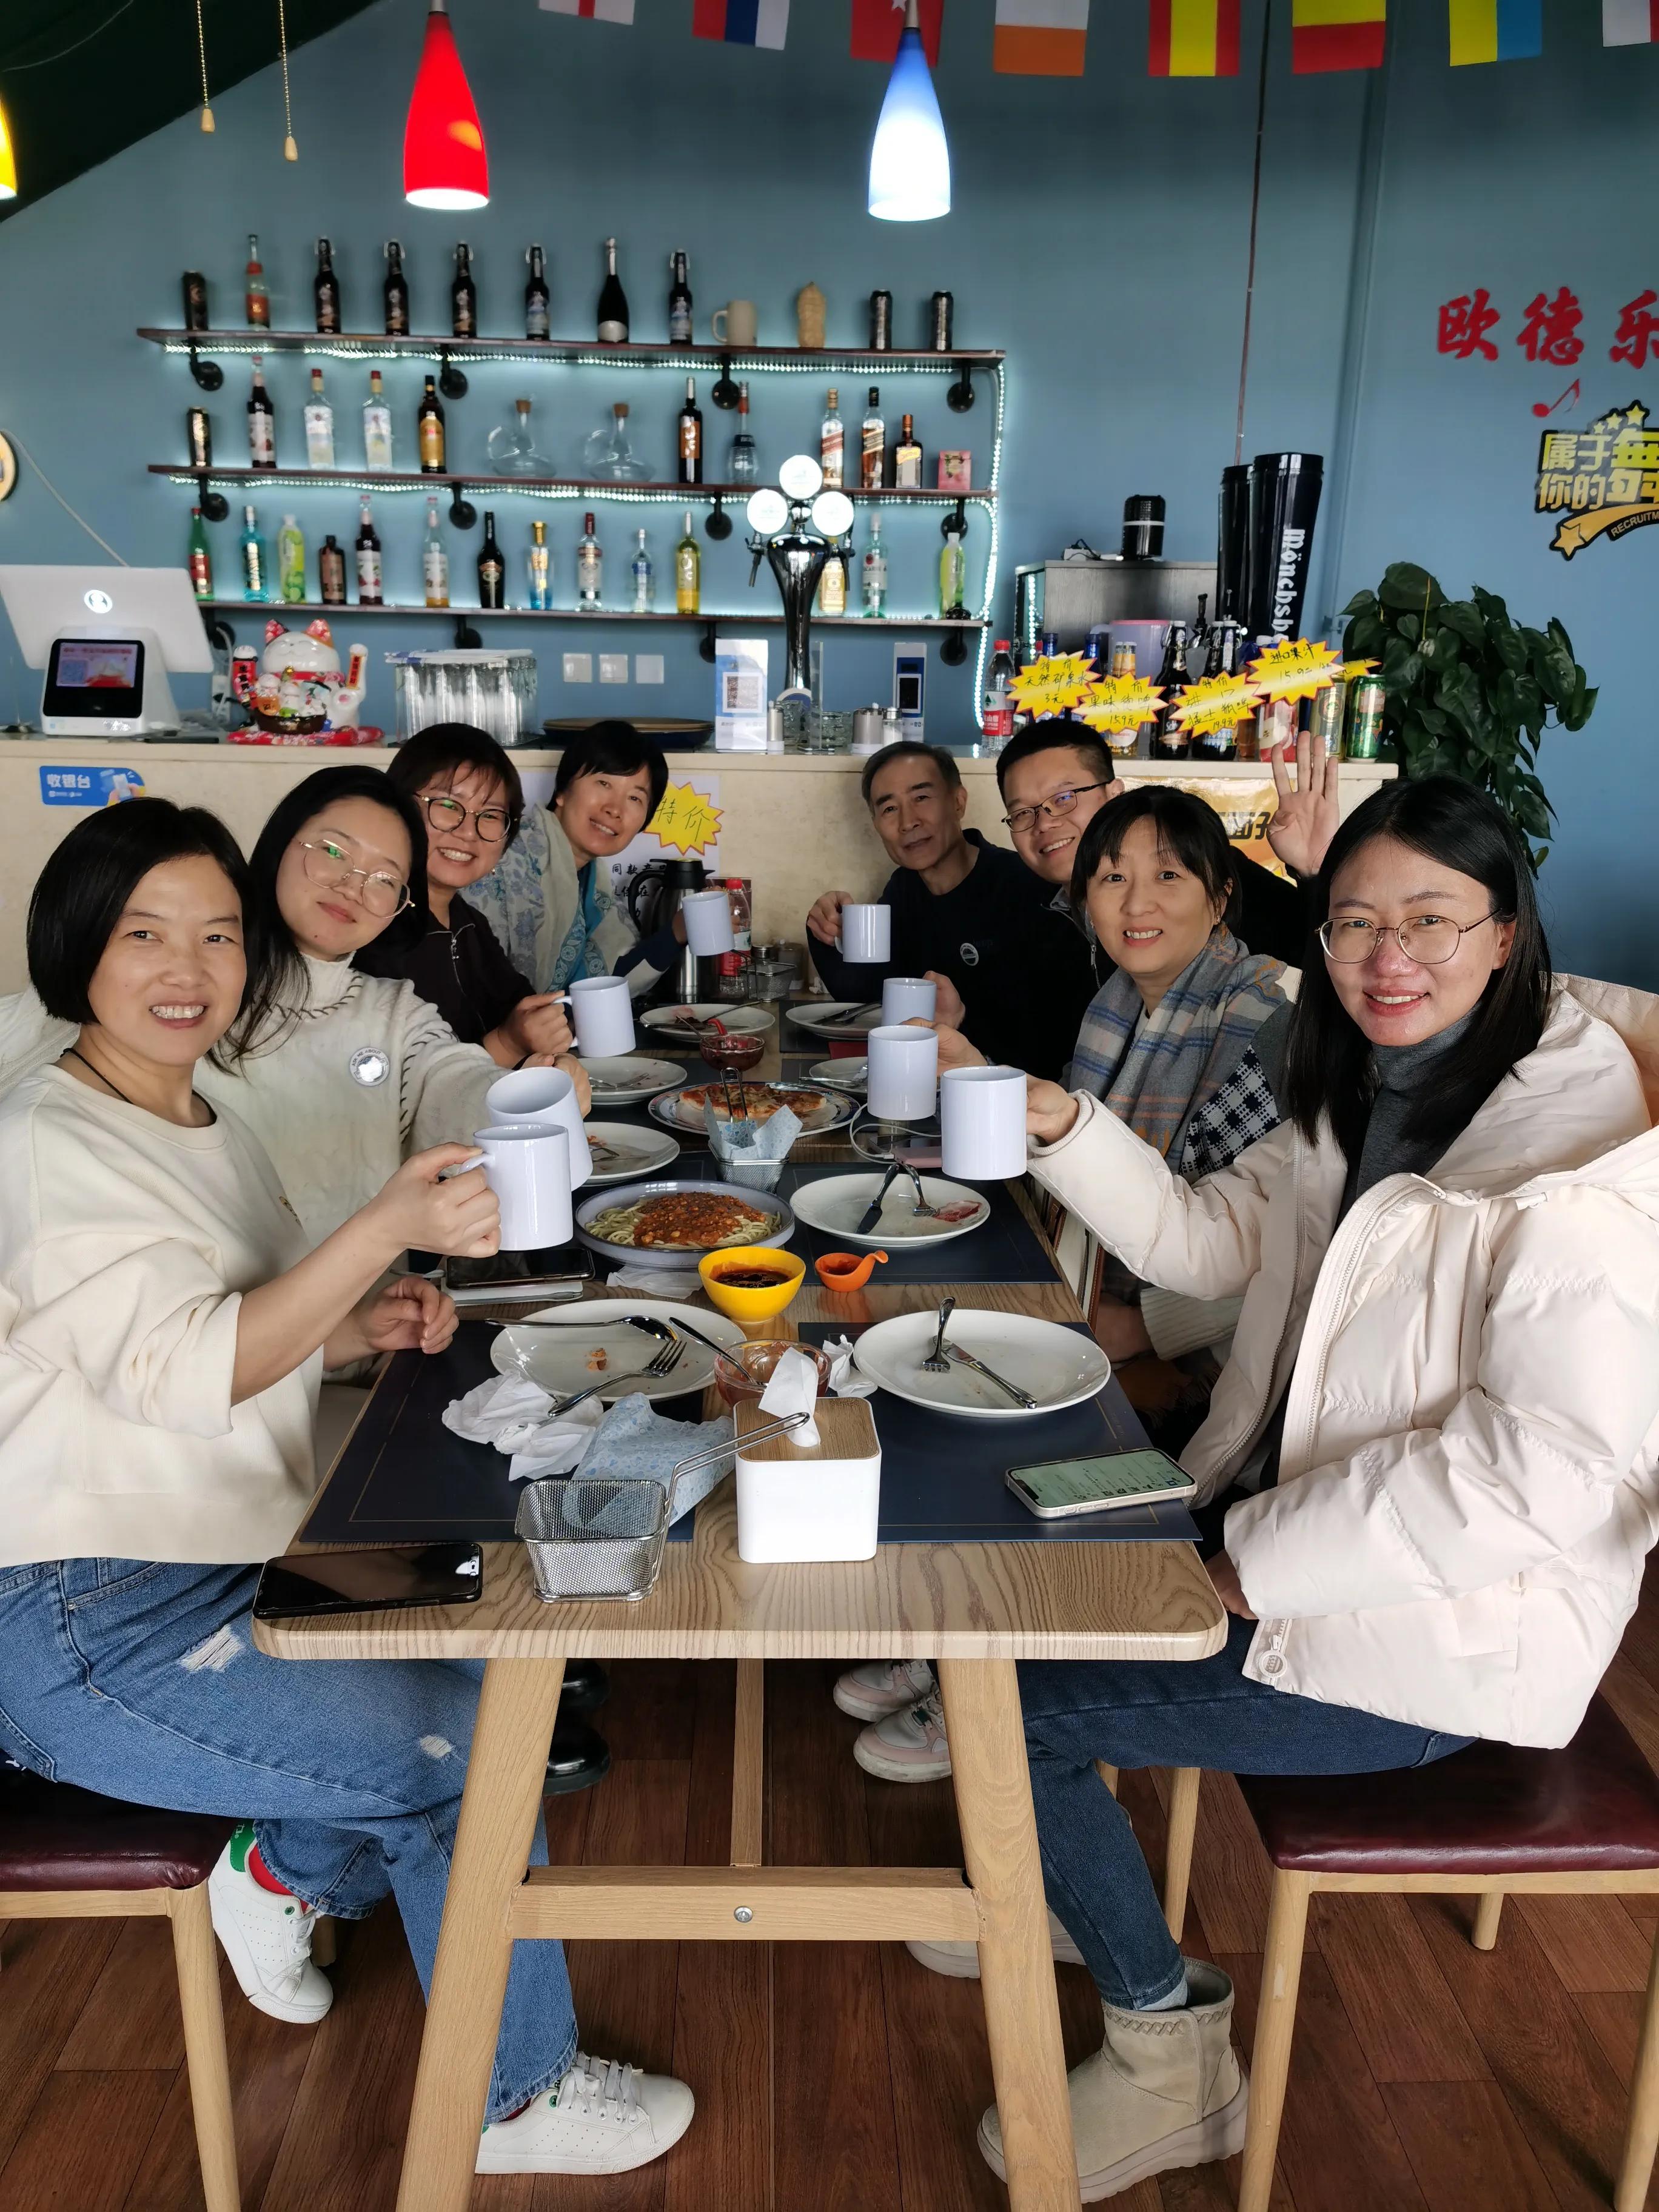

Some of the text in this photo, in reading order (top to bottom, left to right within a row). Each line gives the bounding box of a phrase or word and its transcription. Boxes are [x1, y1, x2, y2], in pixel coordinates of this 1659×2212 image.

[1024, 671, 1091, 692] 天然矿泉水
[1044, 693, 1064, 704] 3元
[1212, 717, 1236, 730] 19.9元
[655, 796, 711, 842] 特价
